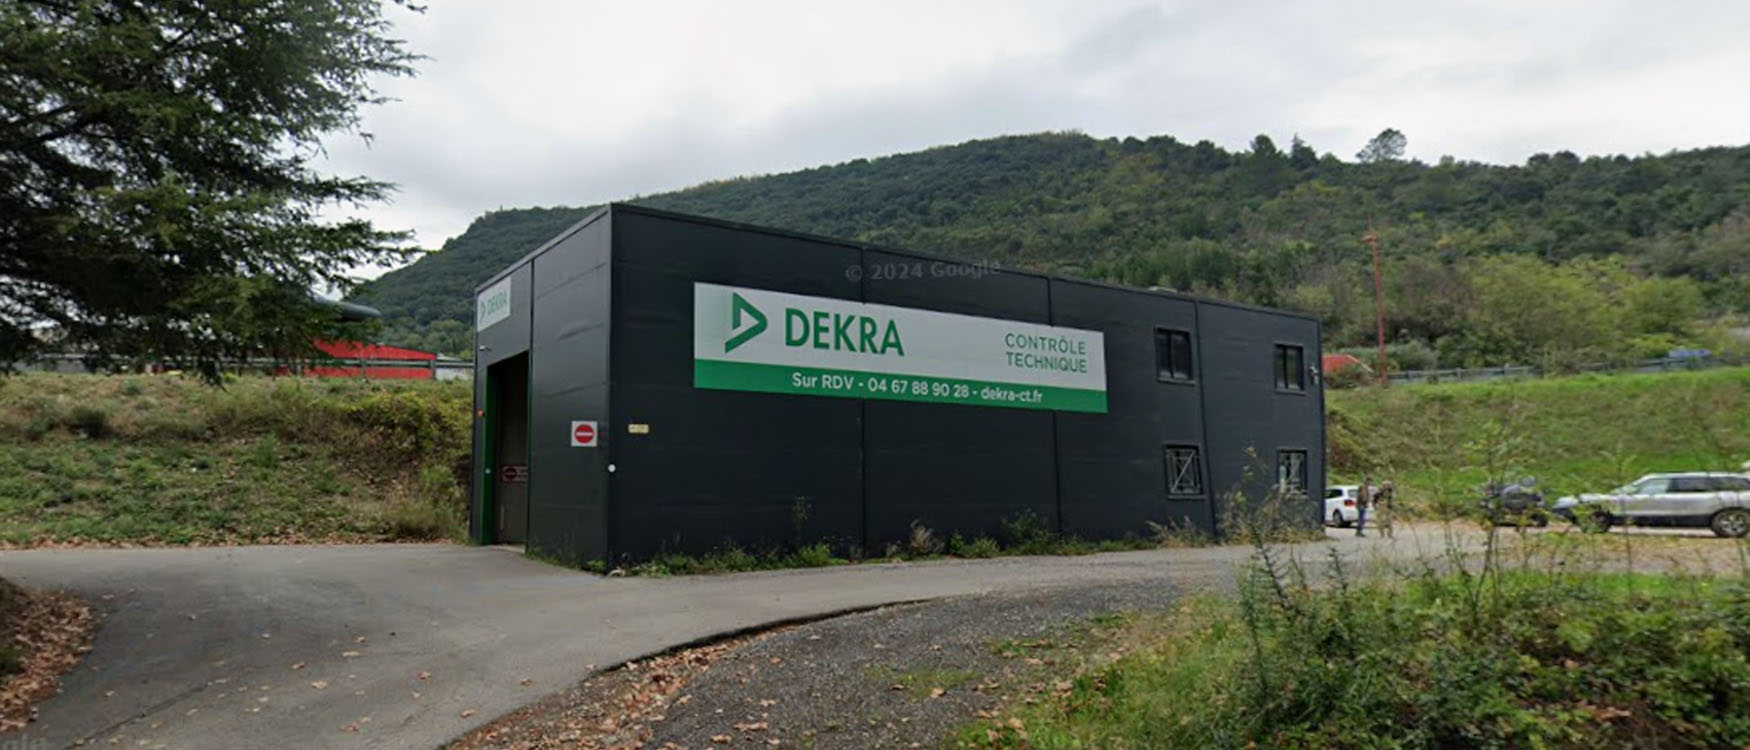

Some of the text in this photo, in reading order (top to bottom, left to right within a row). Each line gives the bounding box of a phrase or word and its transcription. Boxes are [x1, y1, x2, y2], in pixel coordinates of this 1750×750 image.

[785, 308, 905, 357] DEKRA
[1005, 333, 1086, 355] CONTRÔLE
[1006, 352, 1087, 373] TECHNIQUE
[792, 373, 818, 388] Sur
[822, 374, 854, 389] RDV
[867, 378, 887, 392] 04
[891, 379, 908, 393] 67
[911, 381, 928, 395] 88
[932, 383, 949, 397] 90
[953, 384, 970, 397] 28
[980, 386, 1043, 403] dekra-ct.fr
